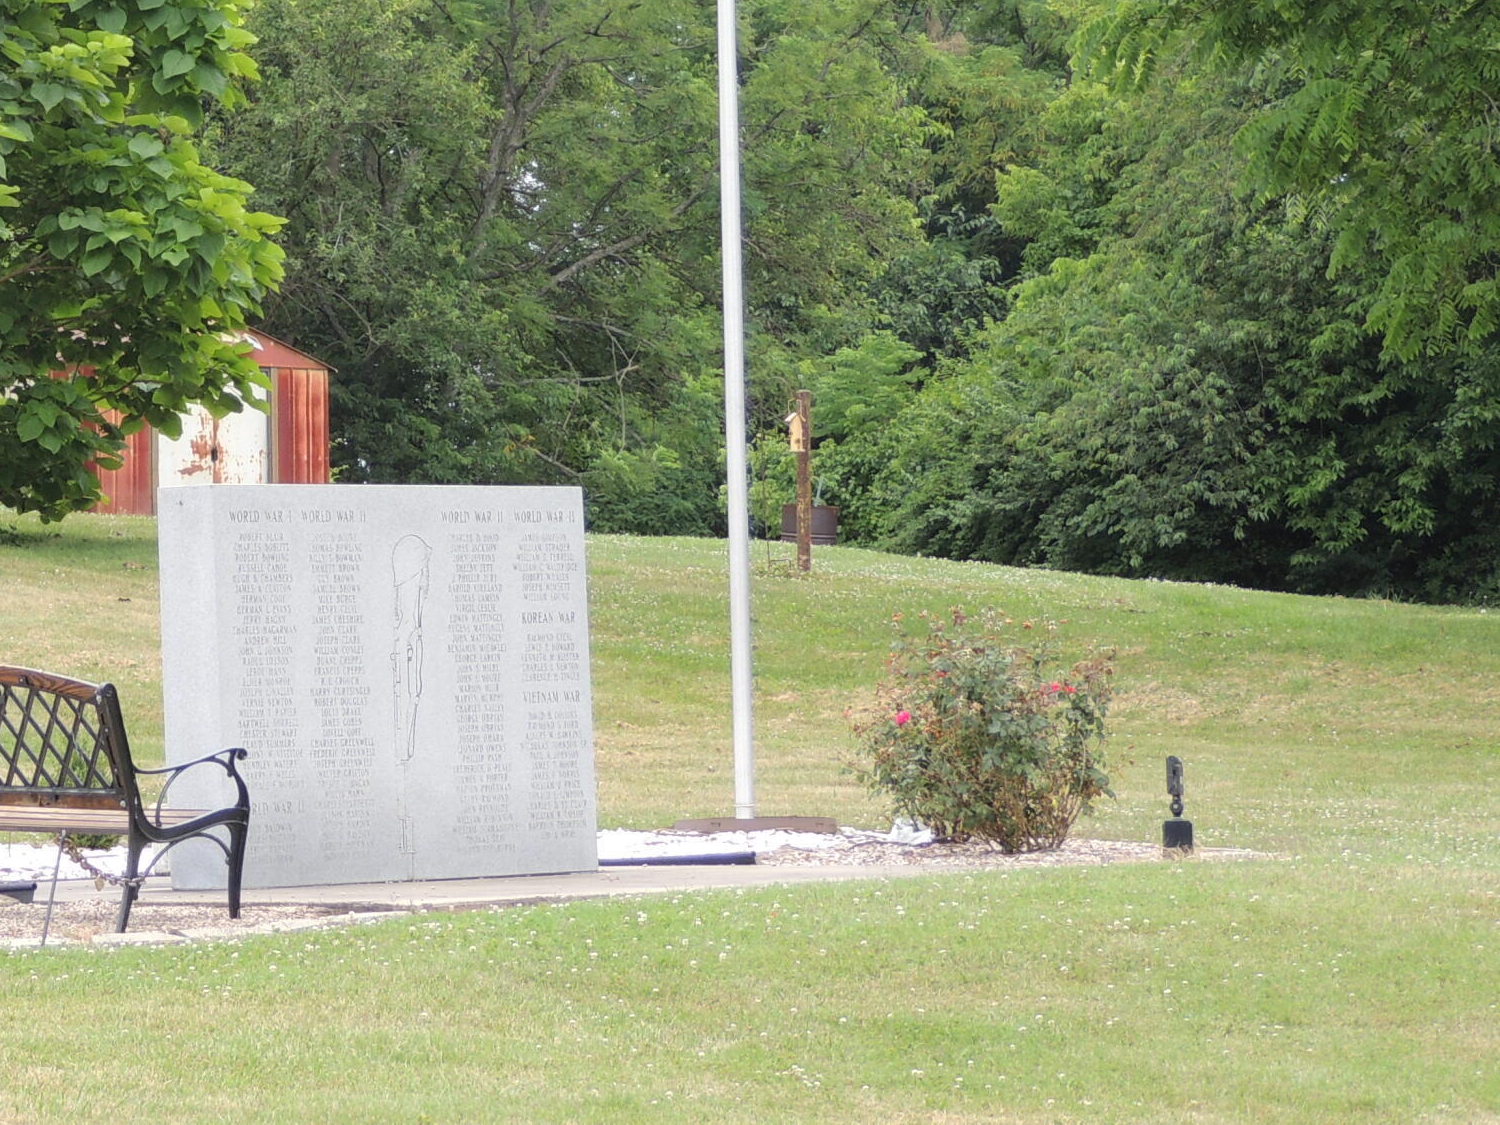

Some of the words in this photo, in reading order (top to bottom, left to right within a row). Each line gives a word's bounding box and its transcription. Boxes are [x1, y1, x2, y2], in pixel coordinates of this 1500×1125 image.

[229, 509, 260, 523] WORLD
[264, 509, 283, 523] WAR
[300, 509, 332, 523] WORLD
[336, 509, 355, 523] WAR
[441, 510, 470, 524] WORLD
[474, 510, 492, 524] WAR
[497, 510, 504, 524] II
[514, 510, 542, 524] WORLD
[547, 510, 564, 524] WAR
[521, 611, 554, 625] KOREAN
[557, 611, 576, 625] WAR
[522, 690, 559, 705] VIETNAM
[562, 690, 581, 705] WAR
[252, 801, 269, 815] RLD
[274, 801, 293, 815] WAR
